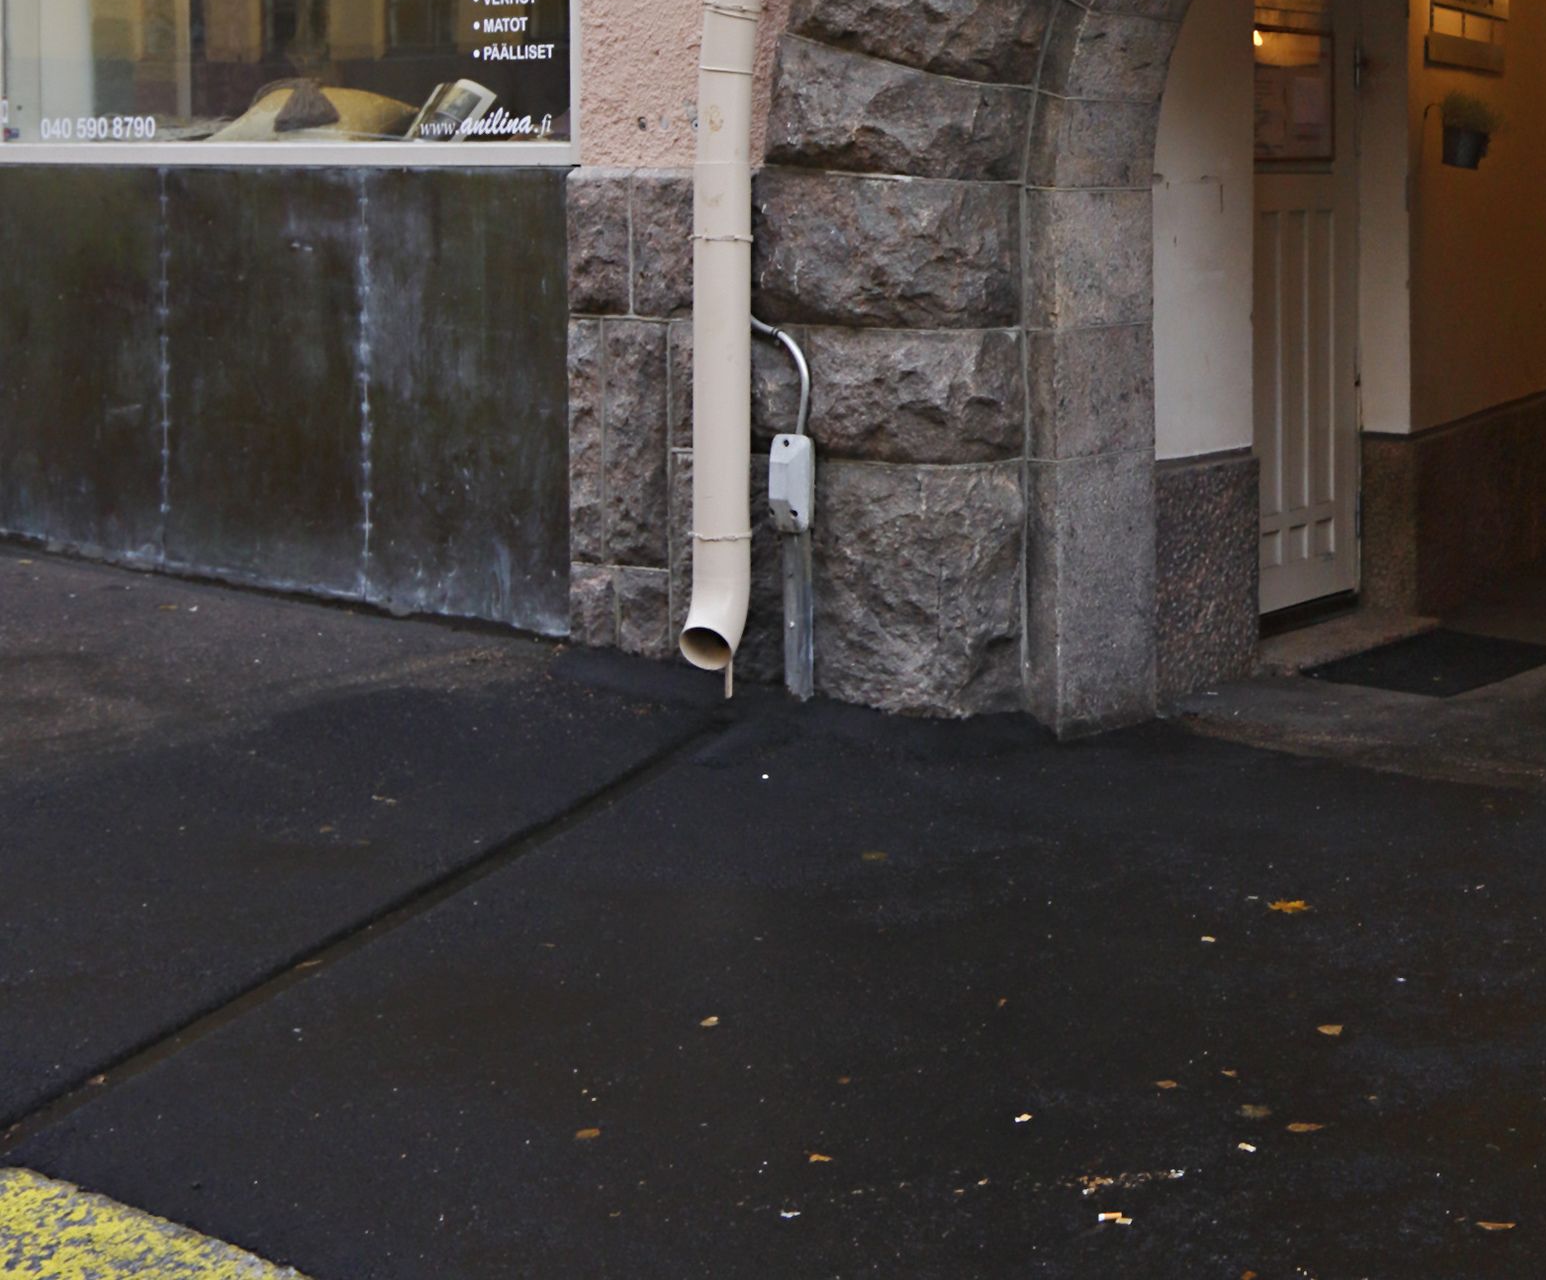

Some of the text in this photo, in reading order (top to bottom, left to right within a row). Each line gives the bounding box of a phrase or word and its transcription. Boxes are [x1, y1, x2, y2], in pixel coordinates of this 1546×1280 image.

[482, 17, 528, 33] MATOT
[482, 42, 555, 61] PÄÄLLISET
[40, 115, 156, 139] 040 590 8790
[419, 106, 552, 139] www.anilina.fi
